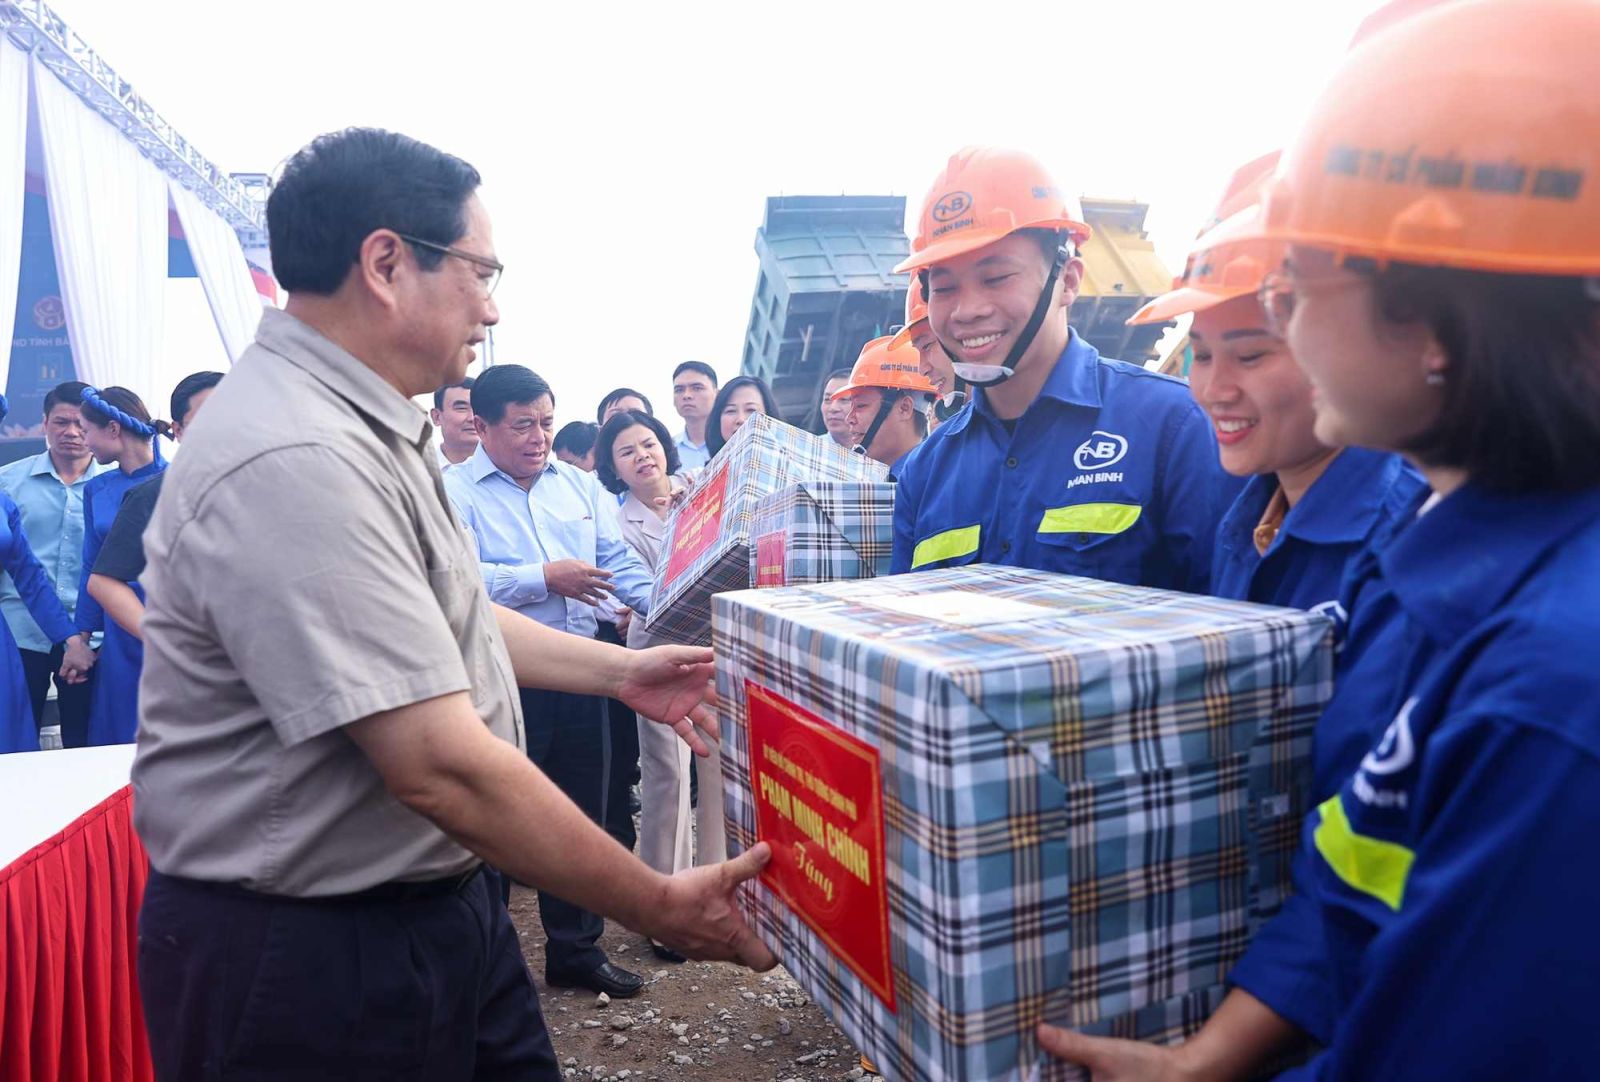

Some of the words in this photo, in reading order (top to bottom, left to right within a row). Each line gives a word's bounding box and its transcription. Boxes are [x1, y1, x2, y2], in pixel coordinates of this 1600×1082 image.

[760, 771, 792, 820] PHẠM
[792, 795, 825, 849] MINH
[826, 822, 871, 886] CHÍNH
